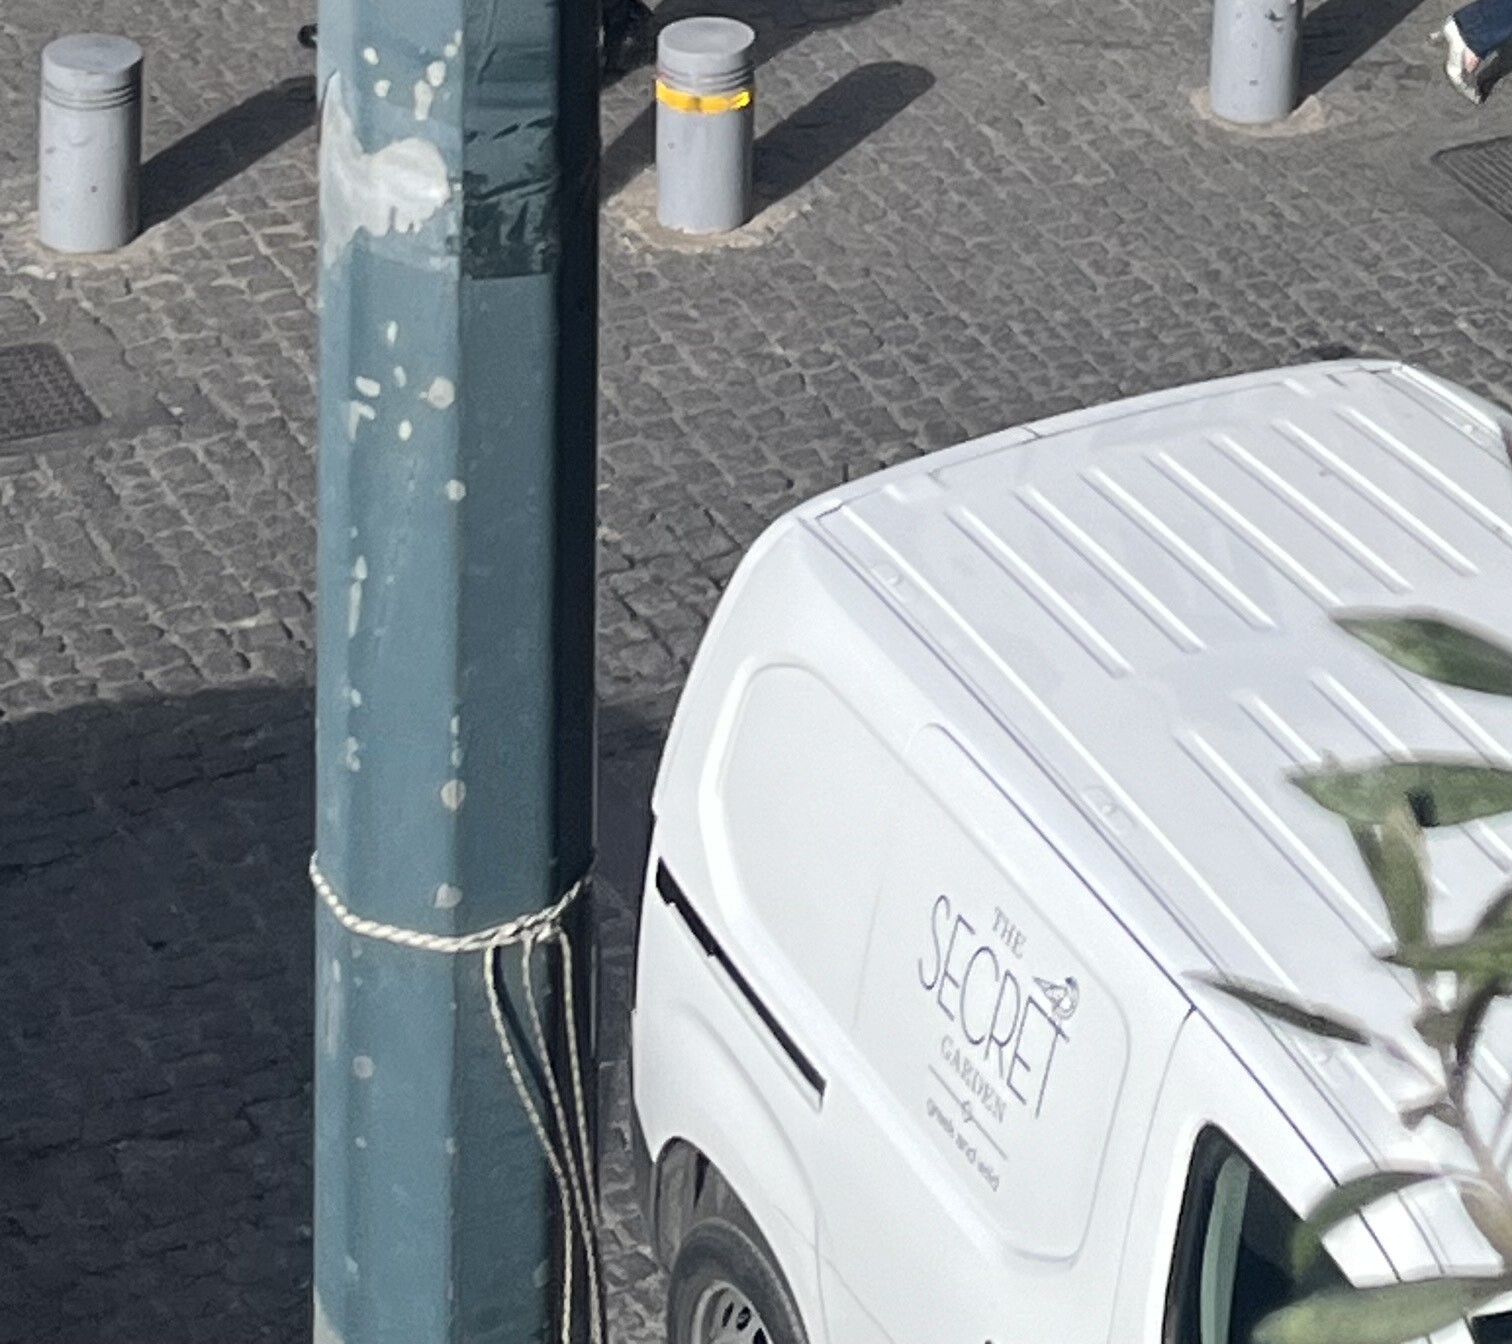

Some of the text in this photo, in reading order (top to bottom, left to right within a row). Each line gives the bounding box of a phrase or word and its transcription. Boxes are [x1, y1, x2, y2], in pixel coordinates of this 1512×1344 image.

[992, 906, 1028, 960] THE
[918, 893, 1070, 1120] SECRET
[941, 1034, 1007, 1125] GARDEN
